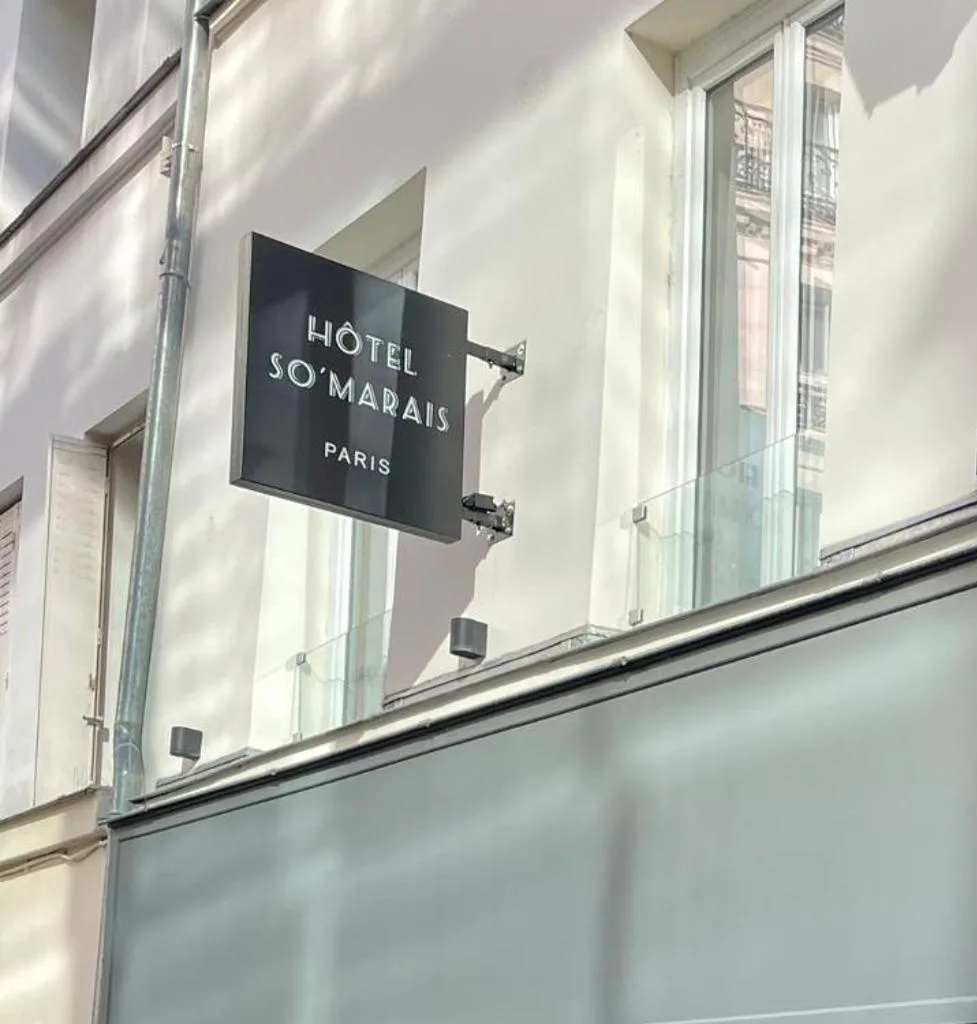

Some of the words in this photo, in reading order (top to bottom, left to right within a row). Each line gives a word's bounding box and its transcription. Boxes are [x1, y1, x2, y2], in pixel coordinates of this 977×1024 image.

[307, 314, 418, 377] HÔTEL
[267, 352, 450, 433] SO'MARAIS
[323, 441, 392, 476] PARIS
